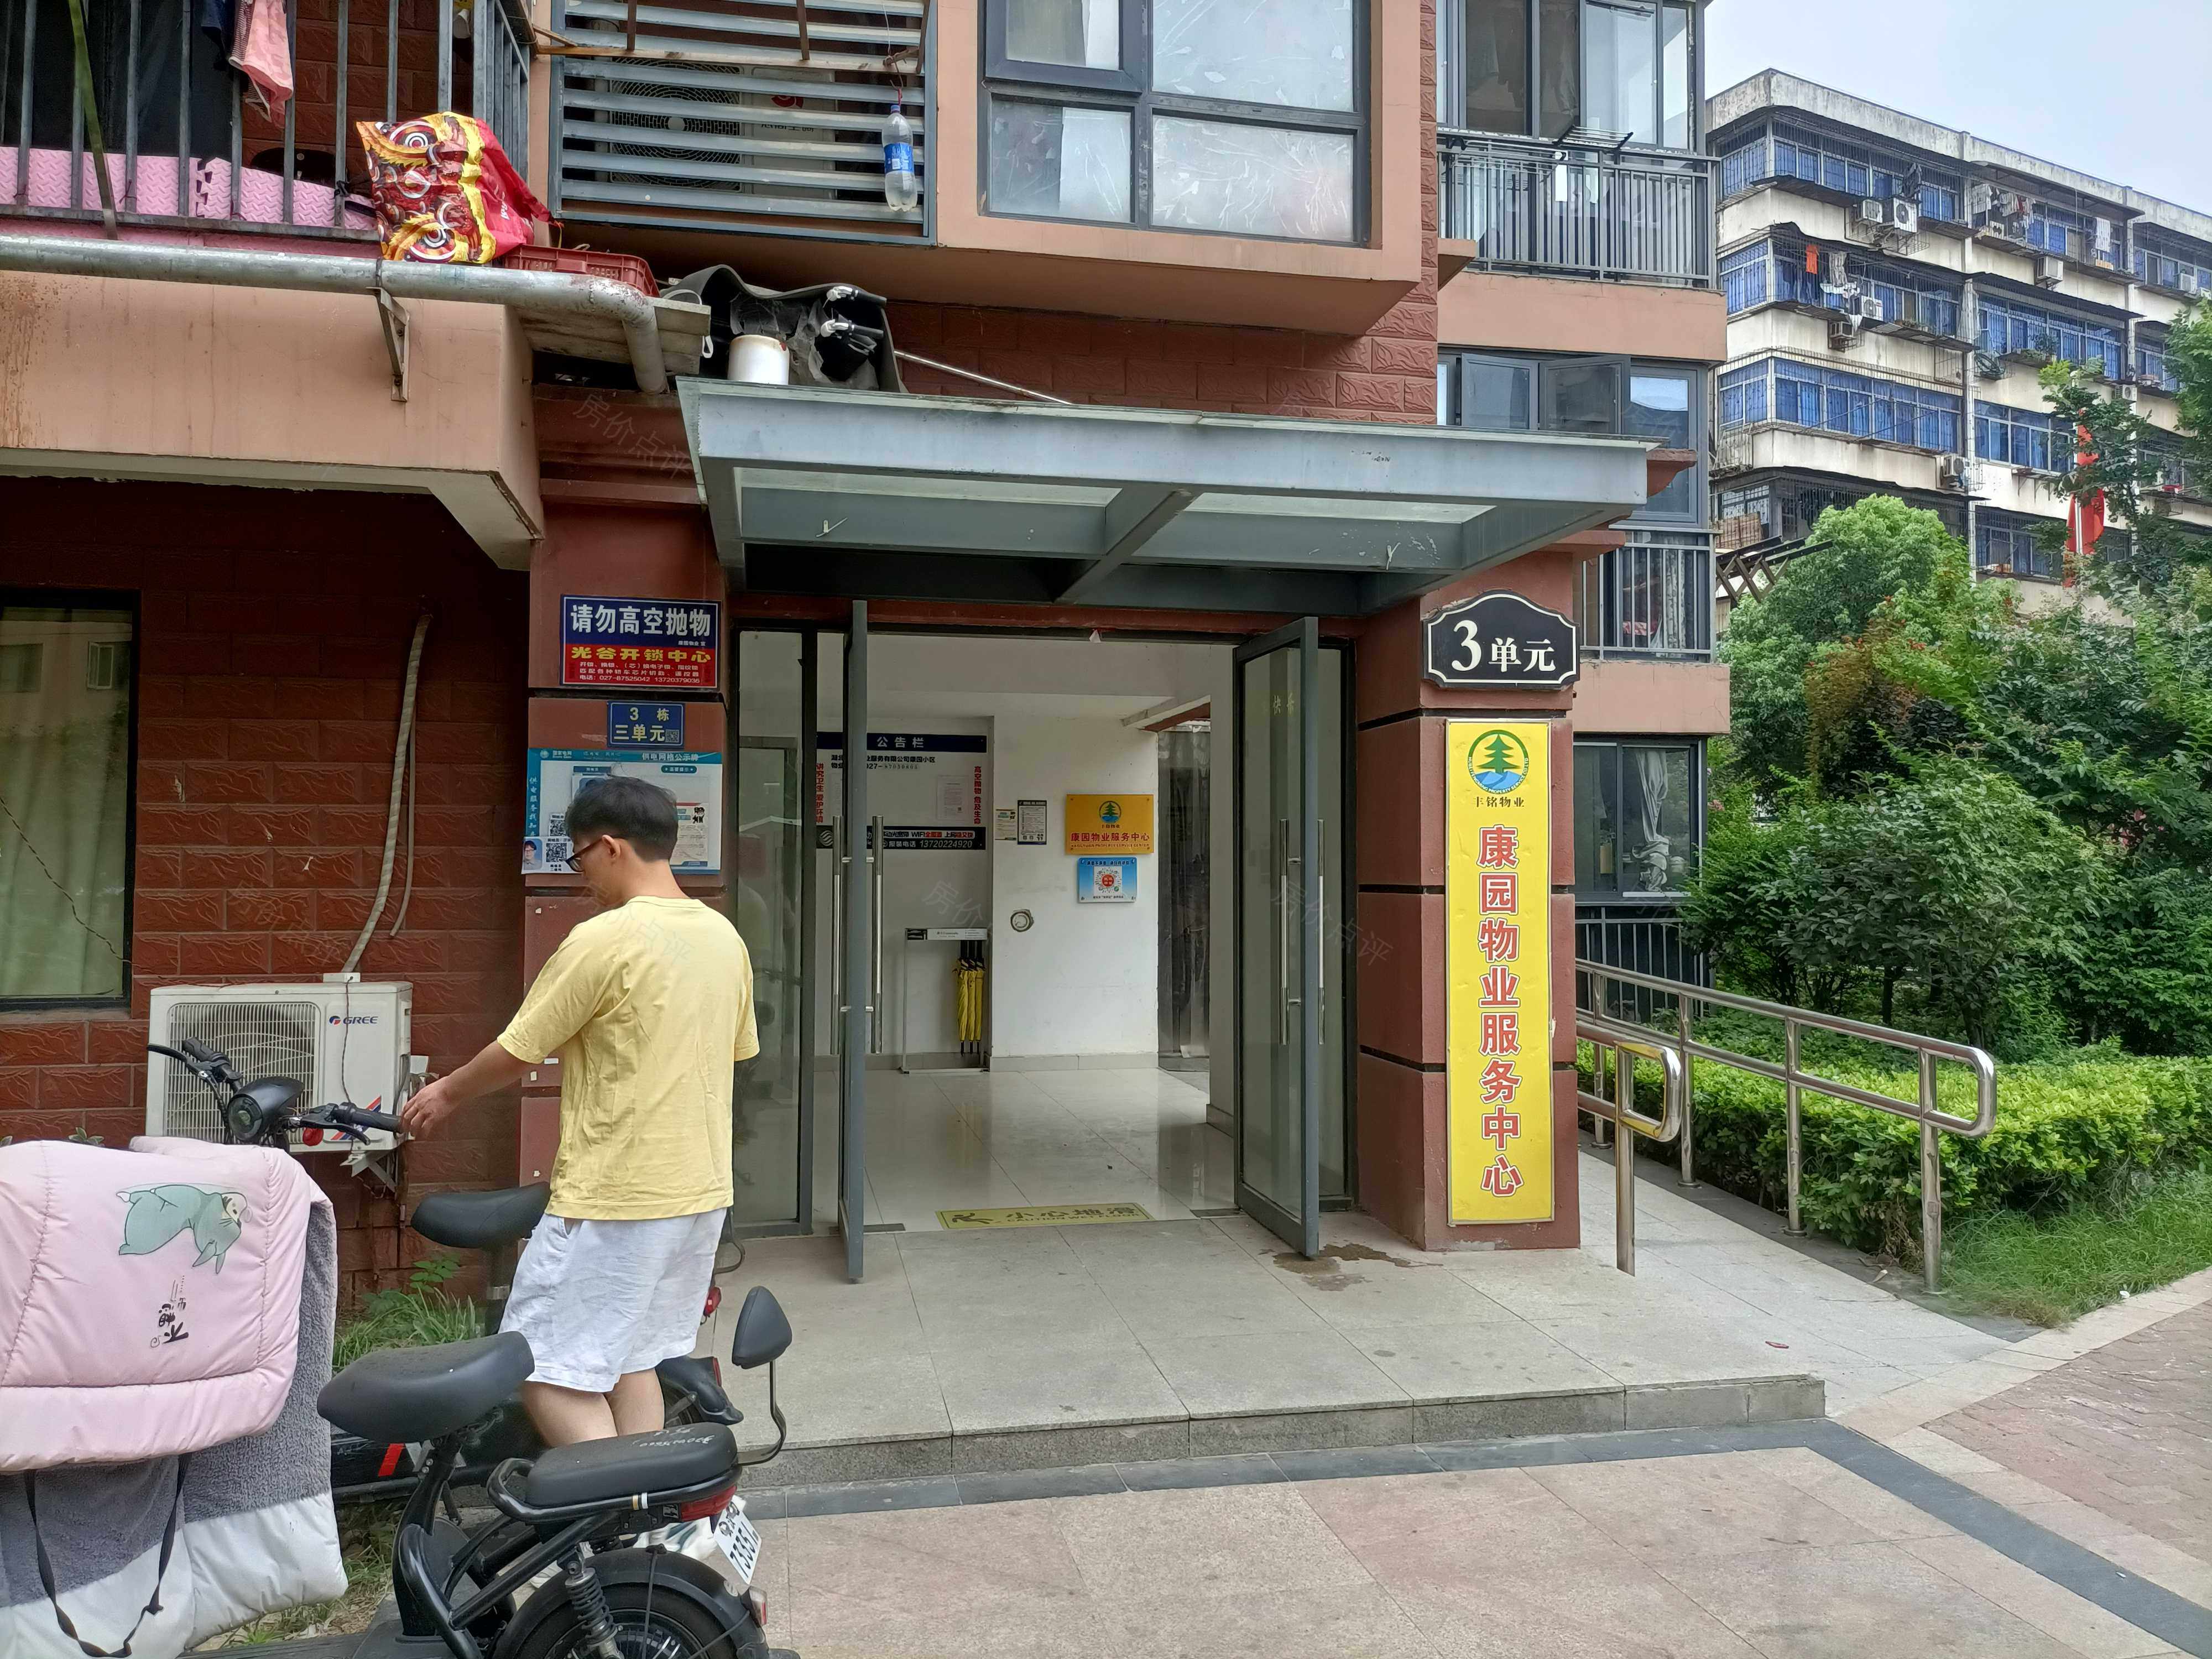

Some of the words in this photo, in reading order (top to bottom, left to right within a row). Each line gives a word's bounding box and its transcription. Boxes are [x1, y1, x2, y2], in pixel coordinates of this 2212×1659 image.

[571, 604, 711, 637] 请勿高空抛物
[1452, 620, 1556, 672] 3单元
[571, 646, 711, 663] 光谷开锁中心
[630, 707, 639, 721] 3
[656, 708, 669, 721] 栋
[614, 724, 665, 742] 三单元
[877, 737, 925, 748] 公告栏
[642, 753, 699, 762] 供电网格公示牌
[920, 840, 973, 848] 13720224920
[1071, 832, 1150, 842] 康园物业服务中心
[1477, 825, 1524, 1197] 康园物业服务中心
